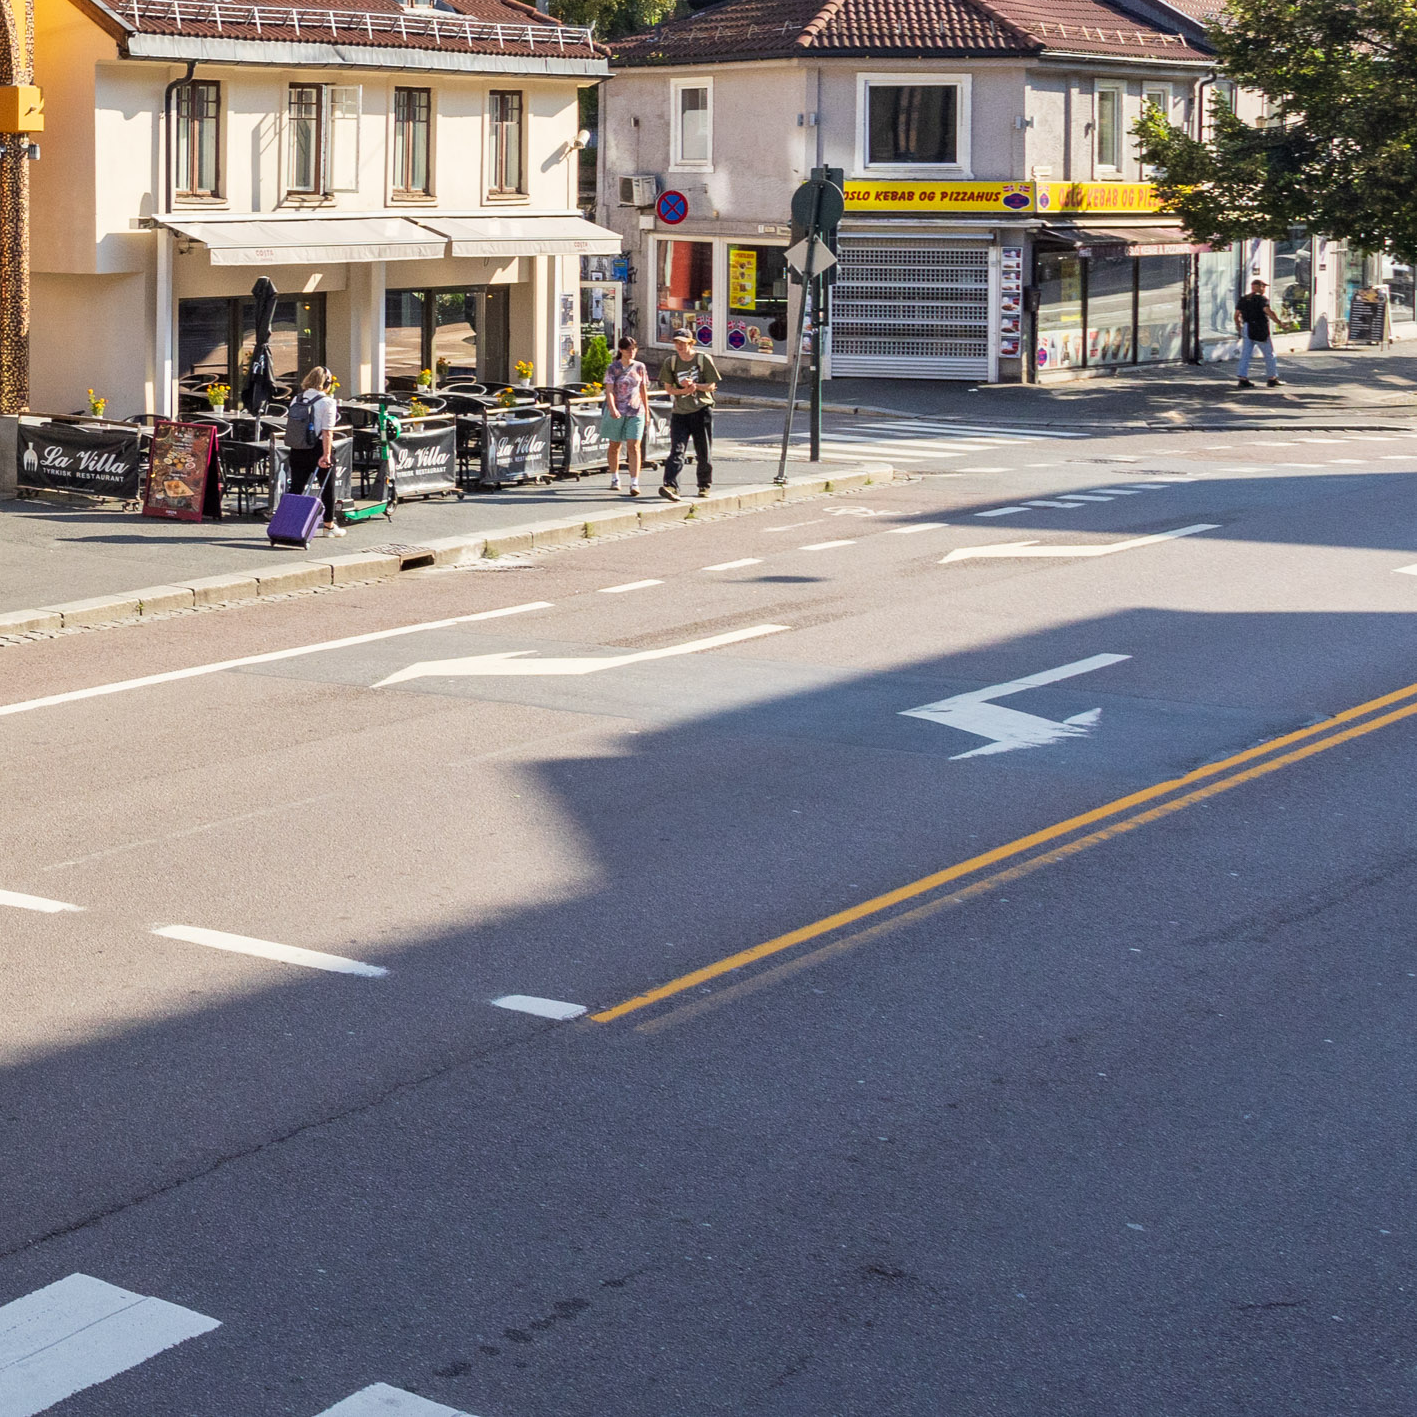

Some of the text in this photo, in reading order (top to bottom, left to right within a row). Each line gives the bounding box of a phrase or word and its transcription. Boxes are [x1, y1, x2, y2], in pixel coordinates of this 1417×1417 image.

[843, 190, 1001, 202] OSLO KEBAB OG PIZZAHUS
[1087, 188, 1118, 208] KEBAB
[1122, 188, 1135, 207] OG
[496, 434, 546, 458] La Villa
[581, 425, 600, 446] La
[40, 446, 130, 475] La Villa
[395, 445, 451, 470] La Villa
[42, 467, 125, 483] TYRKISK RESTAURANT
